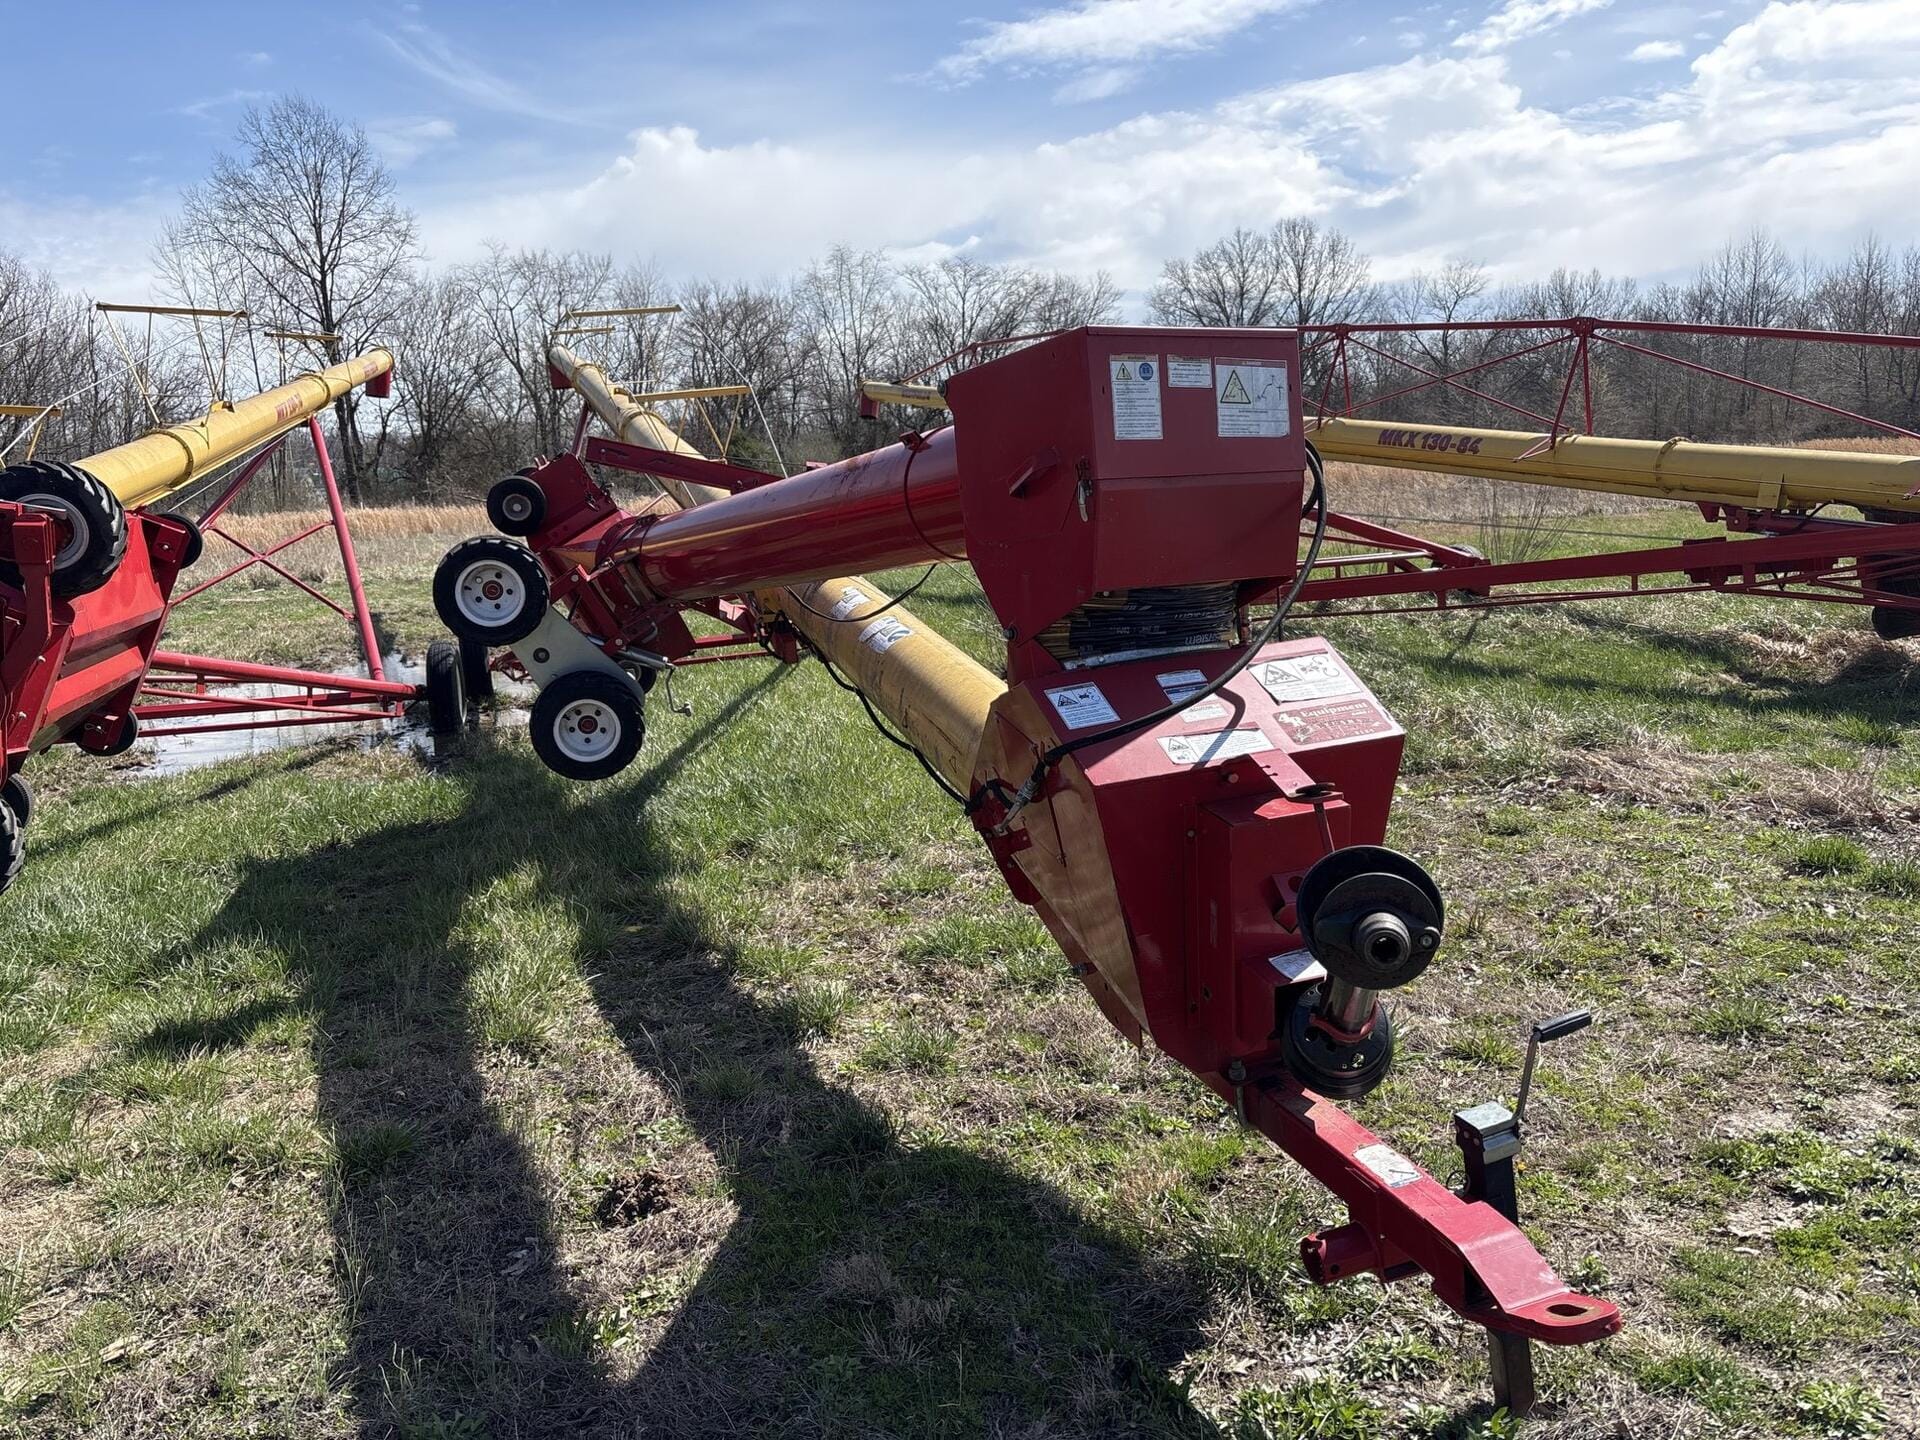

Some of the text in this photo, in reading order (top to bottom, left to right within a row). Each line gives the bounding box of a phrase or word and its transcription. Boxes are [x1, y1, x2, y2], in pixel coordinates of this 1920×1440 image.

[1378, 429, 1483, 455] MKX 130-84
[1299, 702, 1368, 718] Equipment
